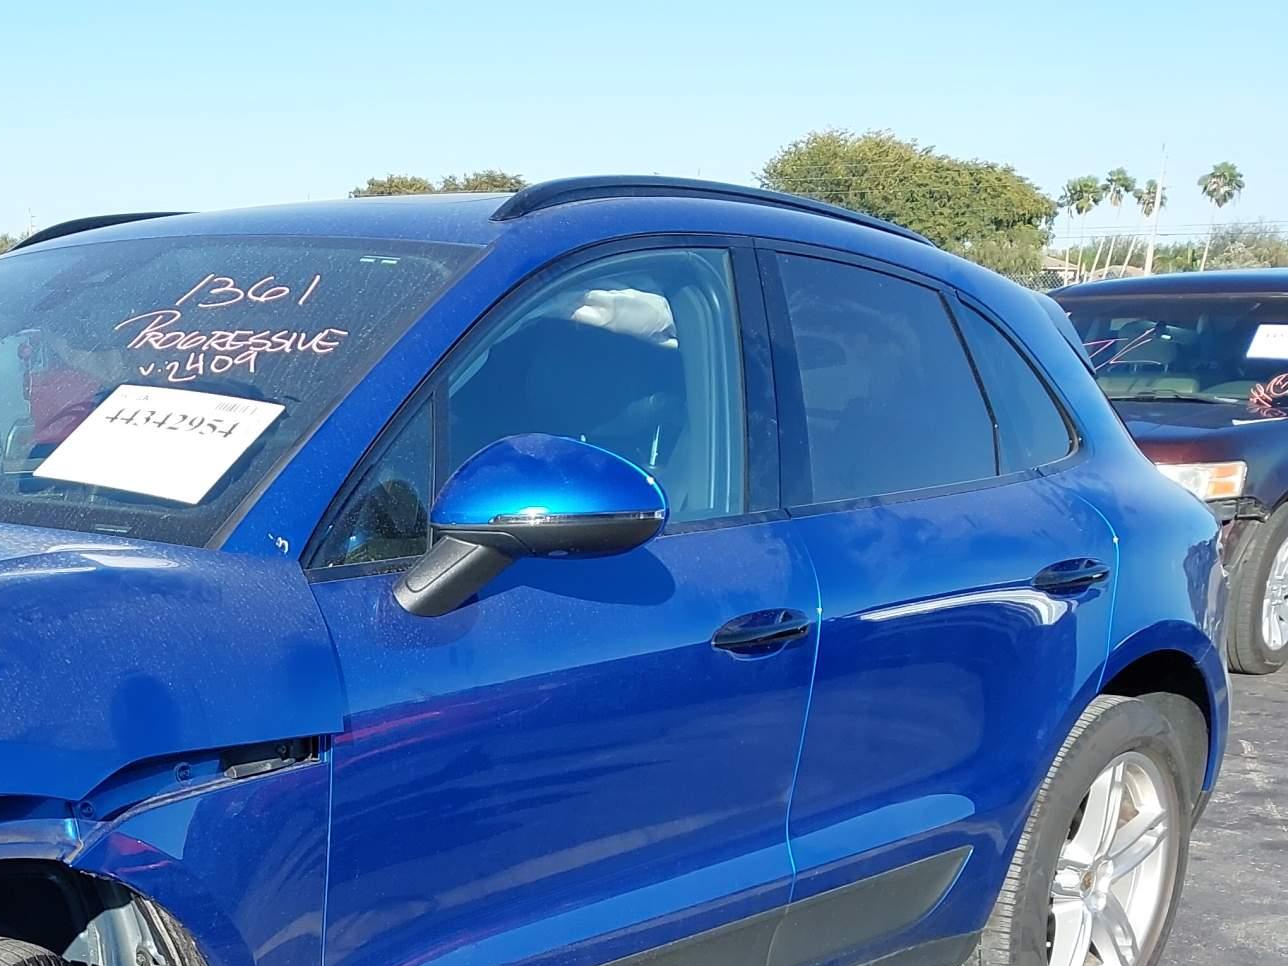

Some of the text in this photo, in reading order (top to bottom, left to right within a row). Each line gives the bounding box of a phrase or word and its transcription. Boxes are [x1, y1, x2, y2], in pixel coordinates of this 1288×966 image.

[175, 273, 321, 307] 1361
[114, 310, 349, 353] PROGRESSIVE
[105, 408, 239, 438] 44342954
